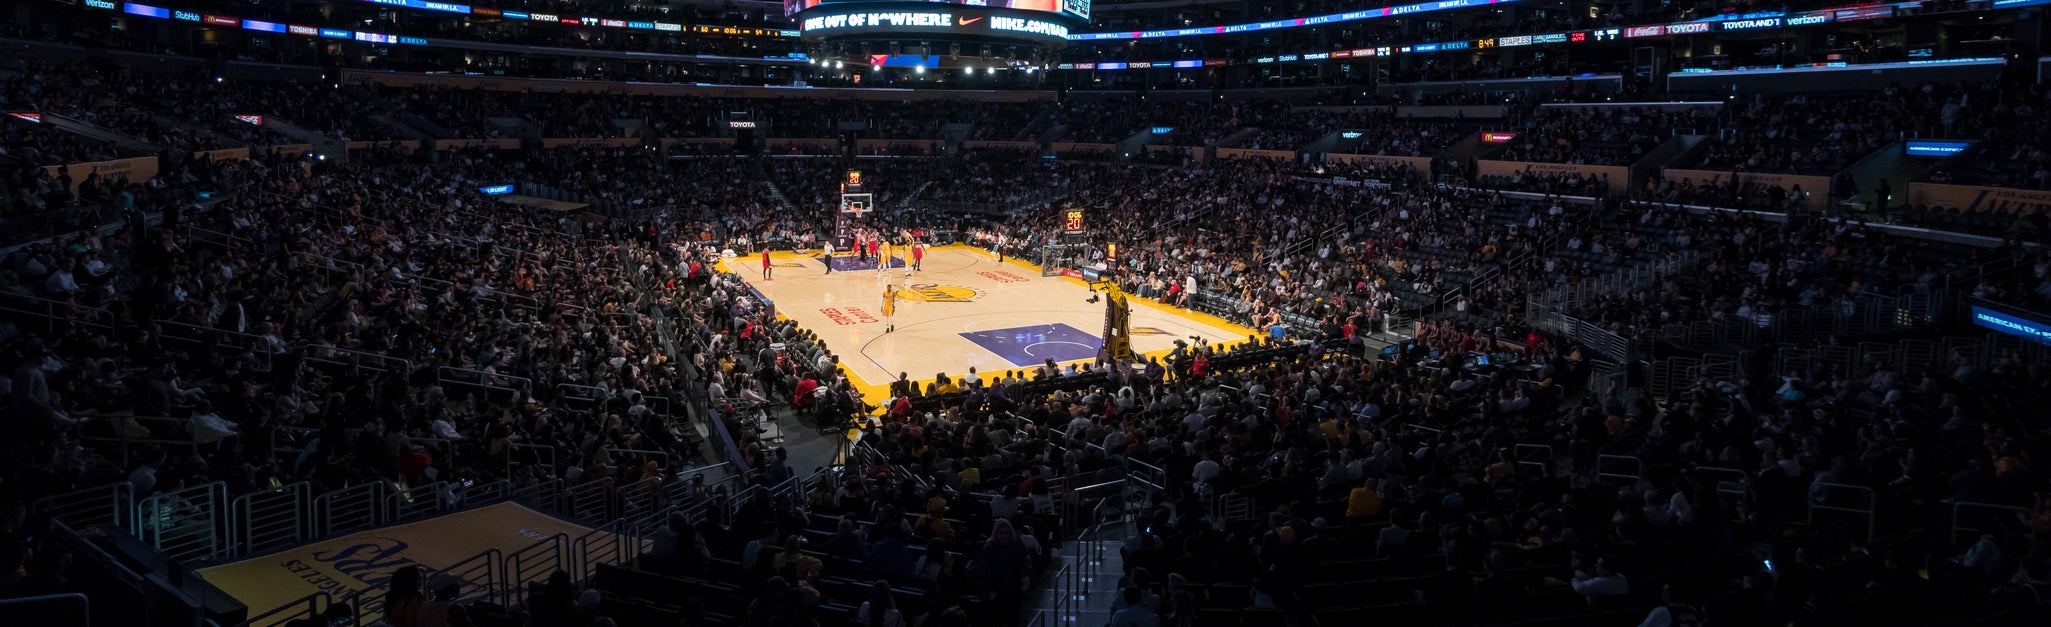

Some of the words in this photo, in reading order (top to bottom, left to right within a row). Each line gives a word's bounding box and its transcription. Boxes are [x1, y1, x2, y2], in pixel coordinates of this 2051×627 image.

[175, 11, 200, 22] StubHub
[530, 13, 558, 21] TOYOTA
[825, 15, 847, 28] OUT
[848, 14, 866, 26] OF
[1787, 15, 1824, 25] verizon
[1666, 23, 1709, 34] TOYOTA
[1723, 20, 1752, 29] TOYOTA
[1751, 19, 1774, 28] AND
[289, 26, 318, 35] TOSHIBA
[1500, 36, 1531, 46] STAPLES
[1352, 49, 1375, 57] TOSHIBA
[1067, 219, 1080, 230] 20
[1978, 313, 2023, 330] AMERICAN
